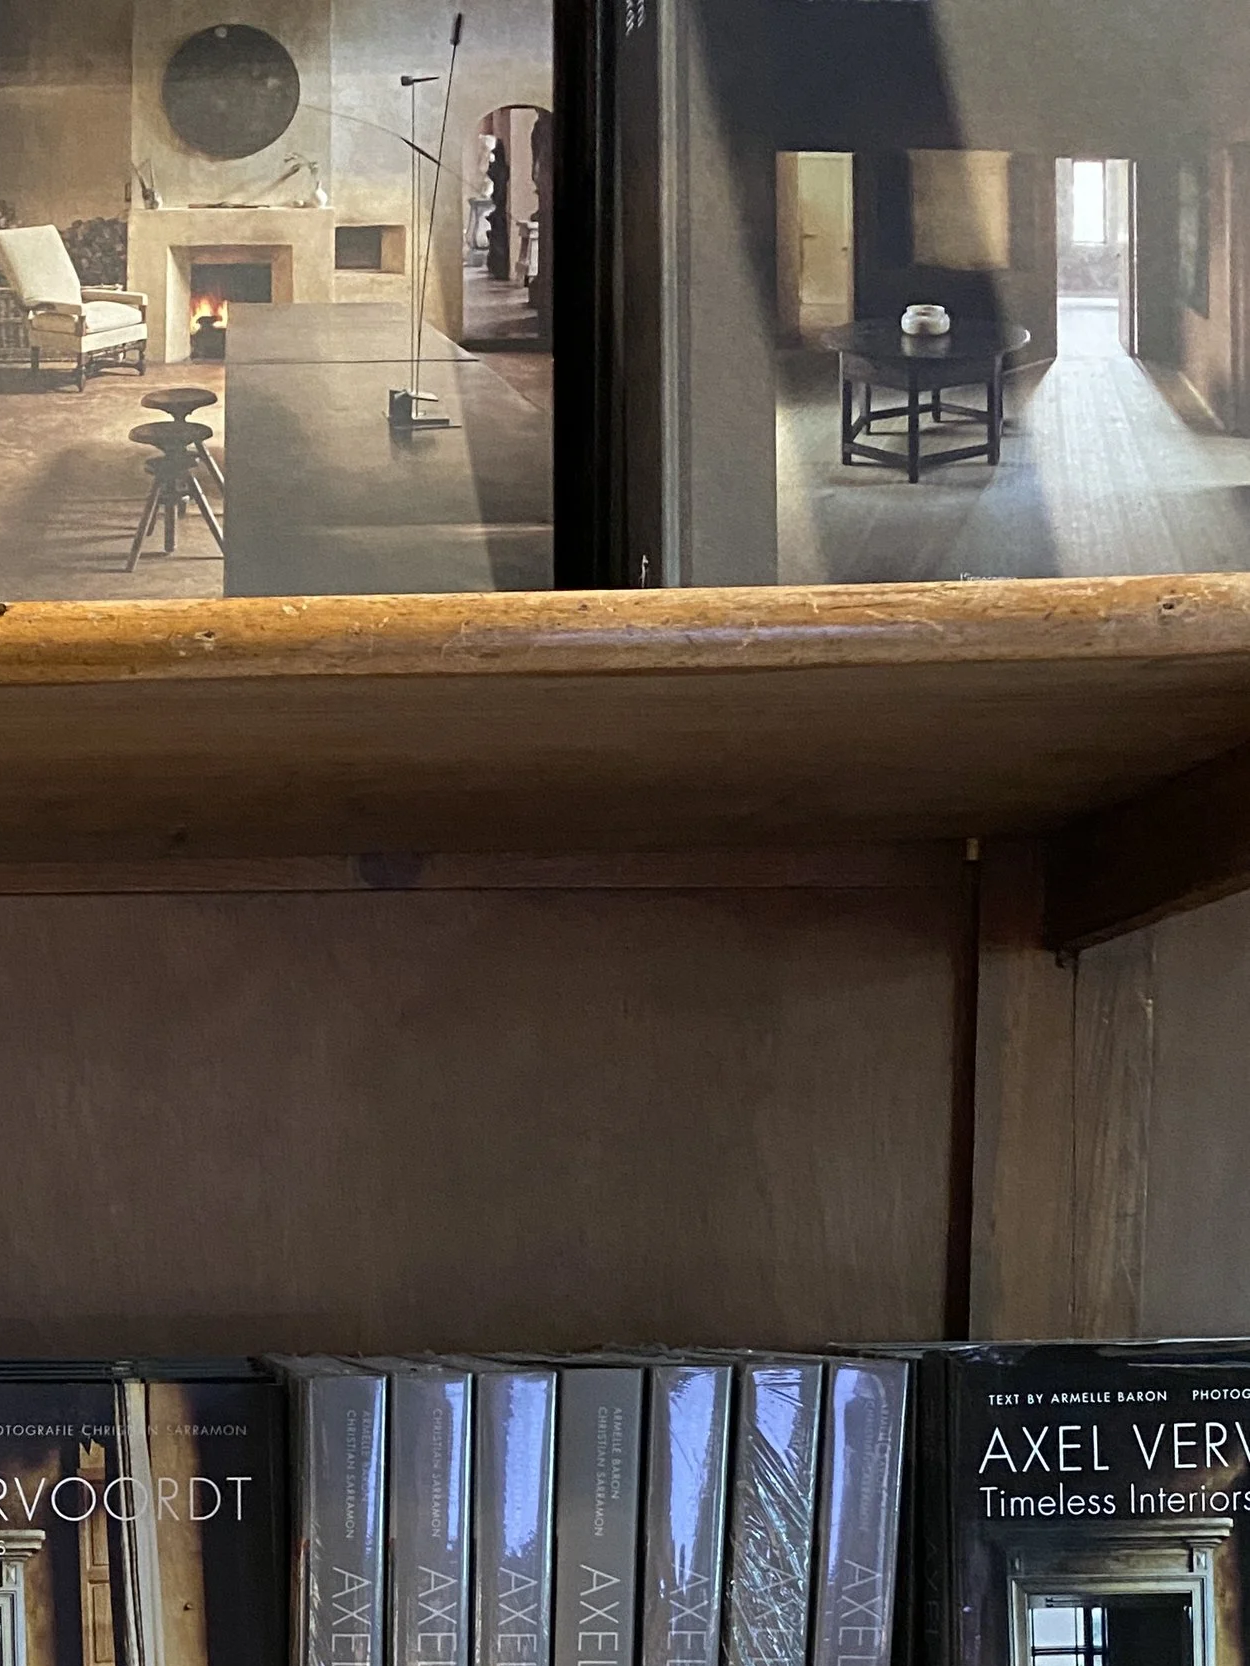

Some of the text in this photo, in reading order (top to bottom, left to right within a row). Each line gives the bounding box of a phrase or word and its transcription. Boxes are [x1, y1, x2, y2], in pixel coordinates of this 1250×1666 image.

[988, 1388, 1250, 1406] TEXT BY ARMELLE BARON PHOTOG
[81, 1424, 159, 1436] CHRIN
[978, 1425, 1110, 1474] AXEL
[594, 1406, 608, 1537] CHRISTIAN SARRAMON
[611, 1407, 623, 1500] ARMELLE BARON
[979, 1482, 1117, 1517] Timeless
